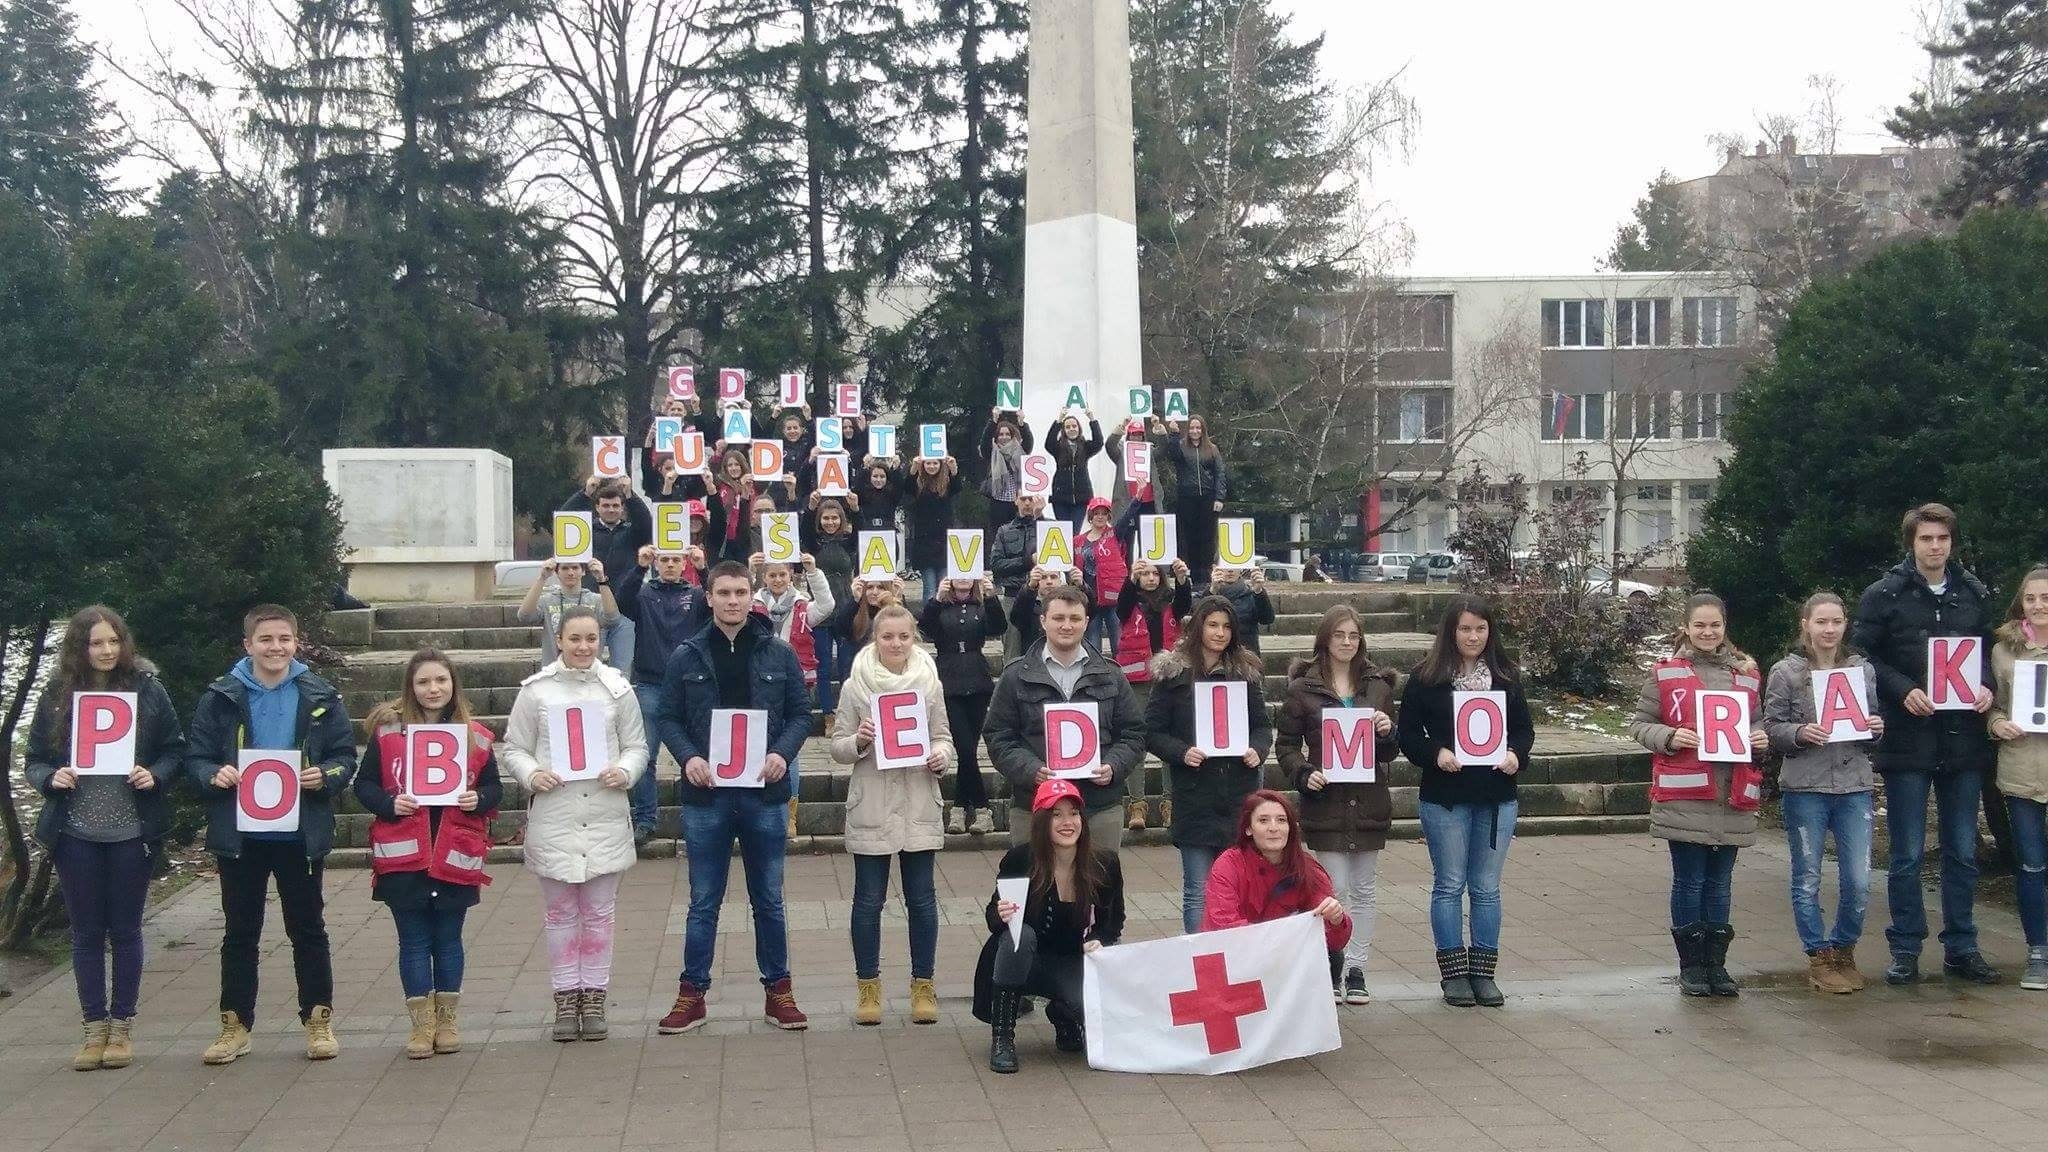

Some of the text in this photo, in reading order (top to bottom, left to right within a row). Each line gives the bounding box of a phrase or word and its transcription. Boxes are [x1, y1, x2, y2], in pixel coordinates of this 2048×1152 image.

[669, 368, 694, 396] G
[721, 370, 744, 397] D
[785, 375, 798, 403] J
[839, 385, 858, 414] E
[997, 381, 1021, 408] N
[1066, 385, 1086, 409] A
[1129, 388, 1151, 414] D
[1165, 391, 1188, 416] A
[725, 412, 750, 438] A
[819, 418, 840, 449] S
[870, 427, 894, 455] T
[923, 425, 945, 457] E
[596, 438, 619, 475] Č
[674, 435, 703, 469] U
[752, 441, 782, 475] D
[1126, 442, 1149, 478] E
[819, 457, 848, 489] A
[1024, 455, 1049, 492] S
[555, 515, 592, 557] D
[657, 504, 684, 551] E
[769, 513, 794, 560] Š
[1038, 526, 1072, 565] A
[1146, 517, 1165, 560] J
[1218, 521, 1254, 565] U
[861, 537, 894, 574] A
[948, 534, 982, 573] V
[1932, 638, 1976, 705] K
[1819, 671, 1868, 736] A
[76, 695, 134, 769] P
[877, 691, 924, 760] E
[1046, 709, 1098, 771] D
[1456, 696, 1502, 757] O
[1702, 694, 1746, 755] R
[716, 713, 748, 780] J
[1322, 717, 1374, 770] M
[412, 730, 463, 796] B
[238, 758, 297, 821] O
